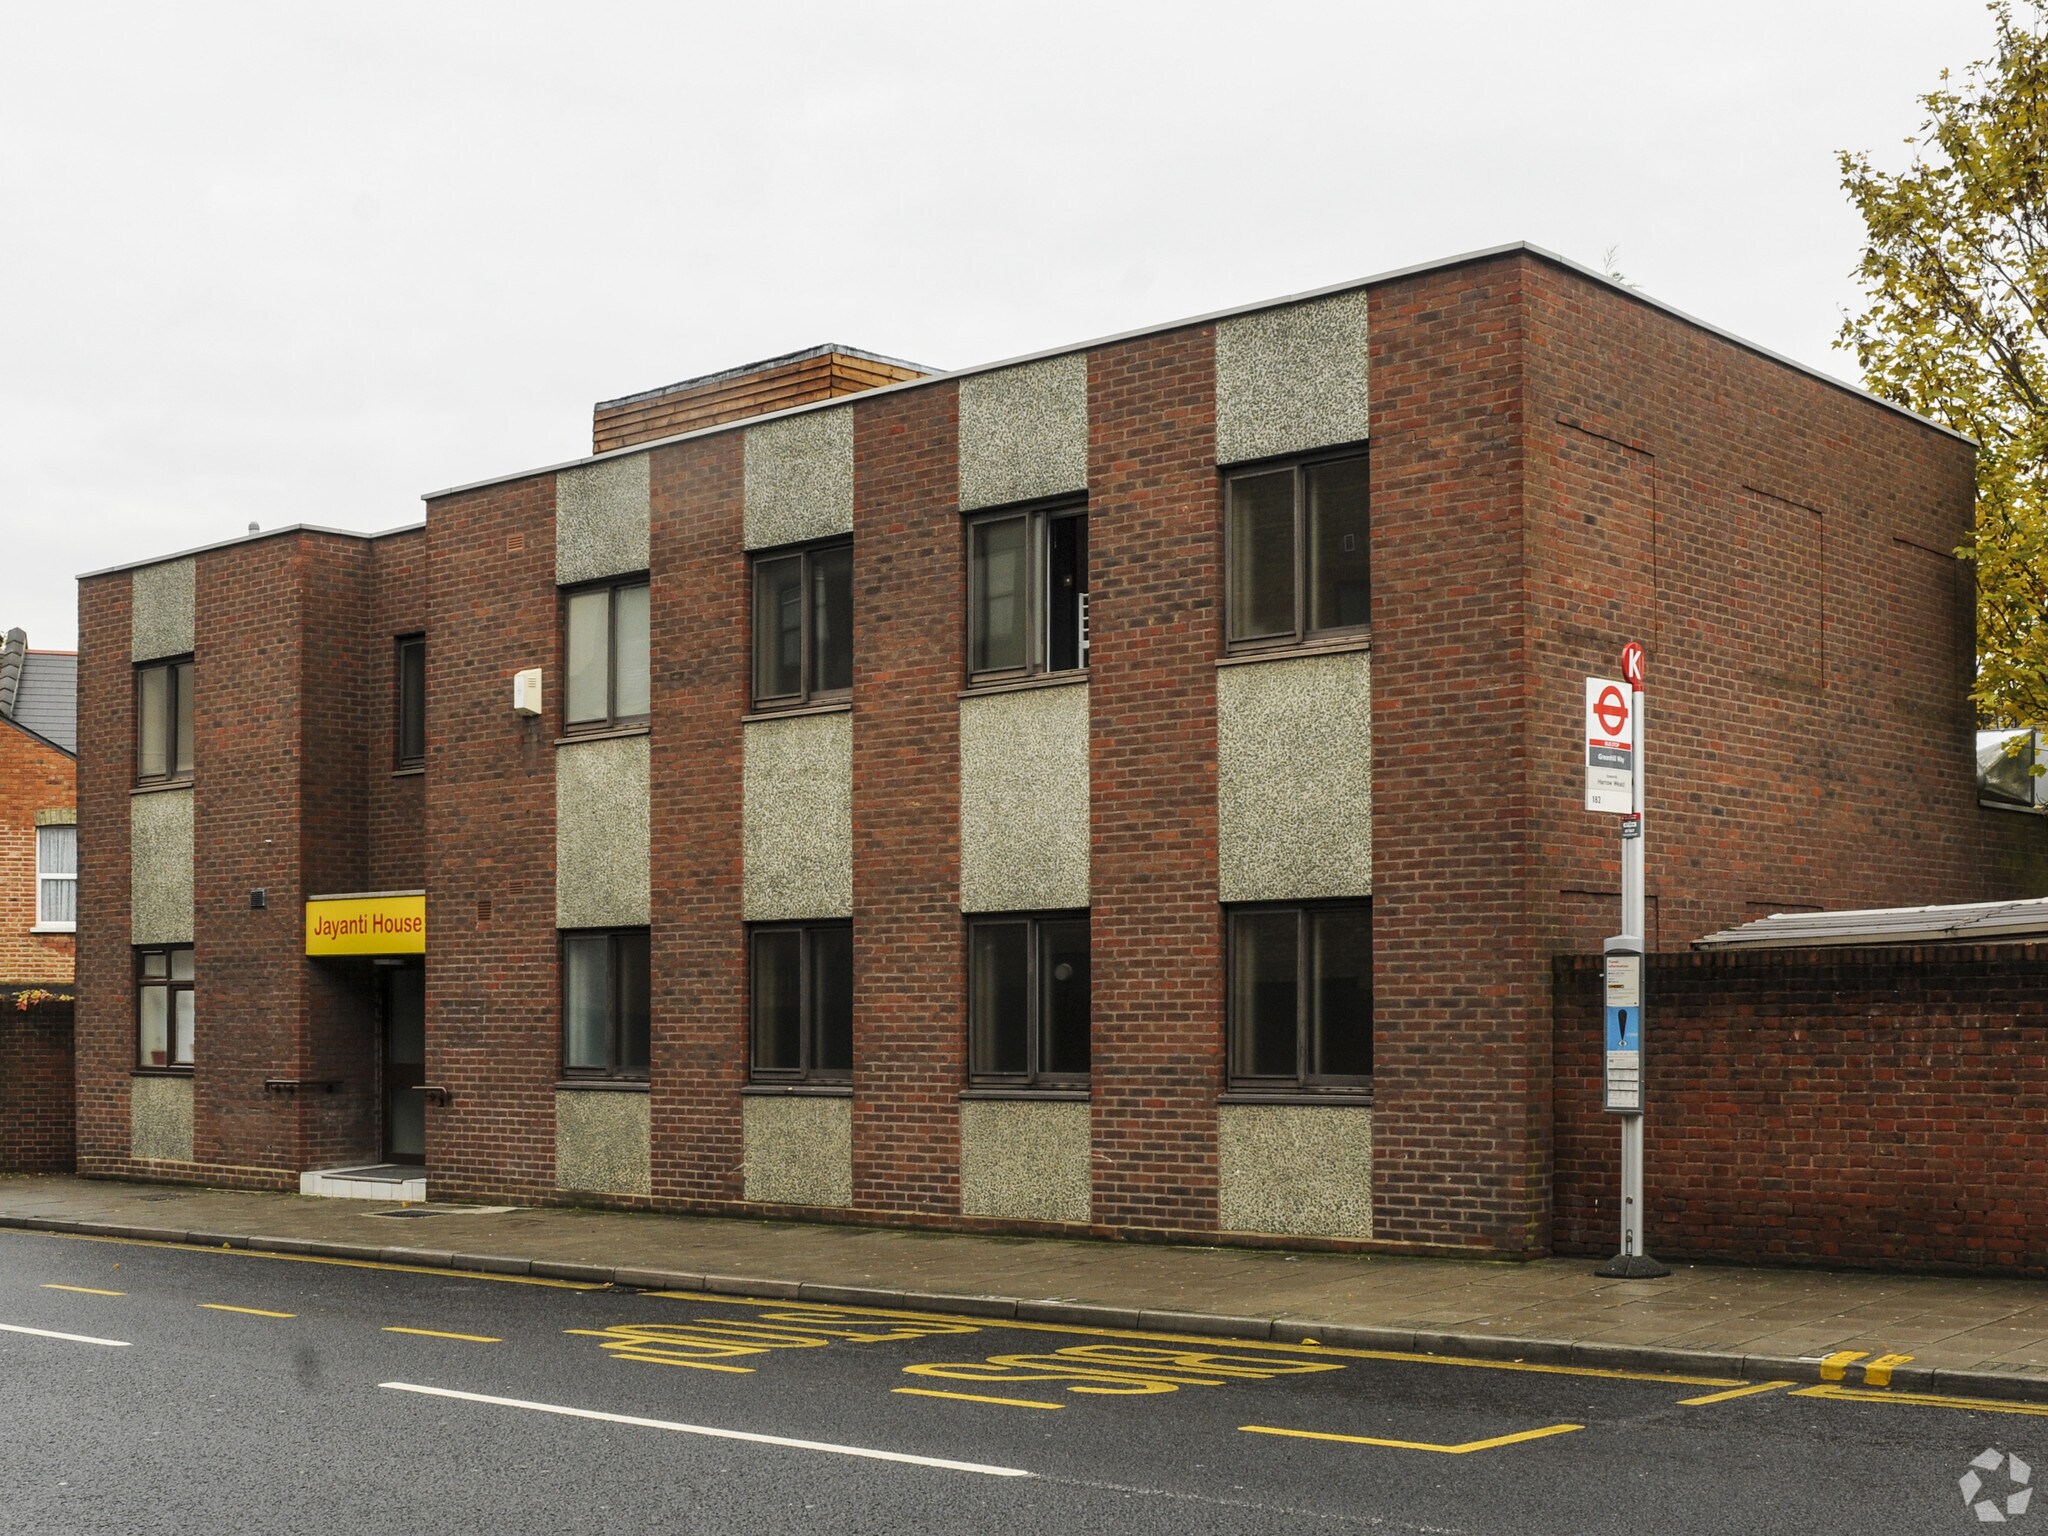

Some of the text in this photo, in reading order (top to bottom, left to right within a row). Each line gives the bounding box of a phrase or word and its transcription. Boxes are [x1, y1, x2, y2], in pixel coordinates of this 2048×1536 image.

[1628, 648, 1641, 680] K
[1597, 753, 1616, 762] Greenhill
[1597, 778, 1613, 786] Harrow
[314, 913, 422, 940] Jayanti House
[561, 1312, 1347, 1395] BUS STOP
